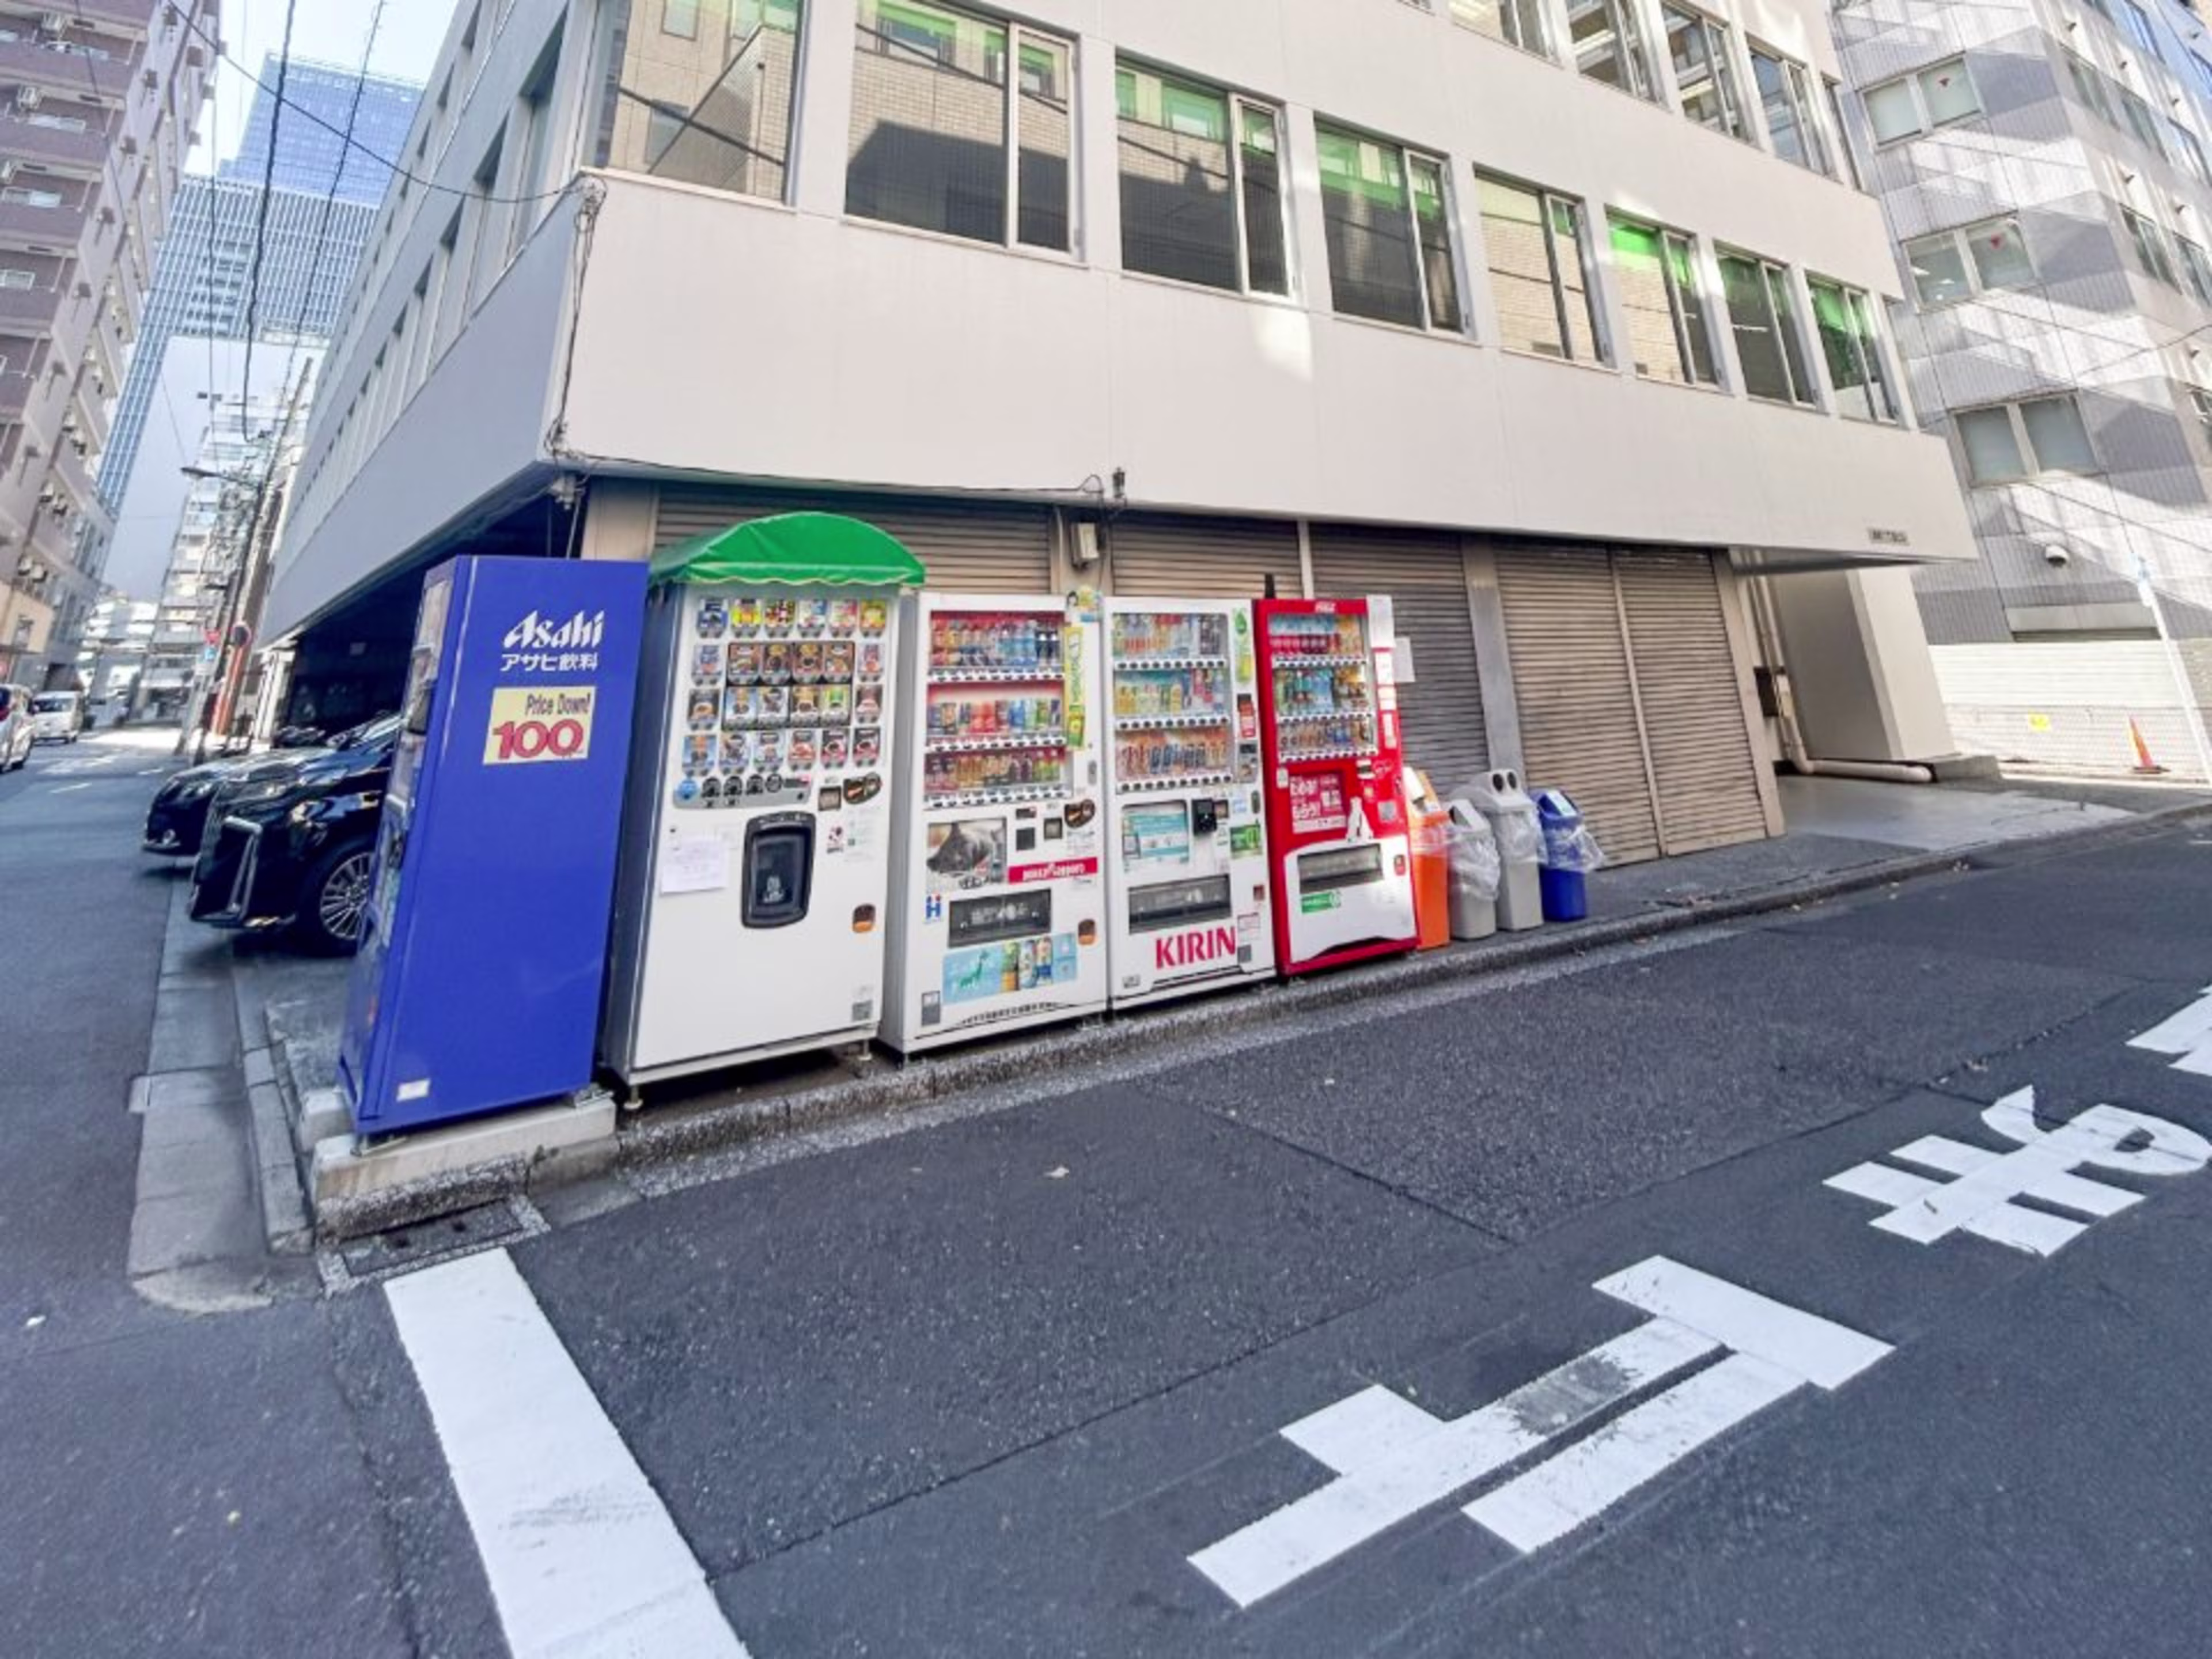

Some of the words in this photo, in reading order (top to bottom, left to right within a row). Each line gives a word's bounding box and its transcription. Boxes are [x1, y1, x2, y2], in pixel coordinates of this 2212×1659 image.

[503, 610, 605, 649] Asahi
[500, 652, 598, 672] アサヒ飲料
[525, 694, 552, 714] Price
[492, 718, 584, 760] 100
[1156, 926, 1237, 970] KIRIN
